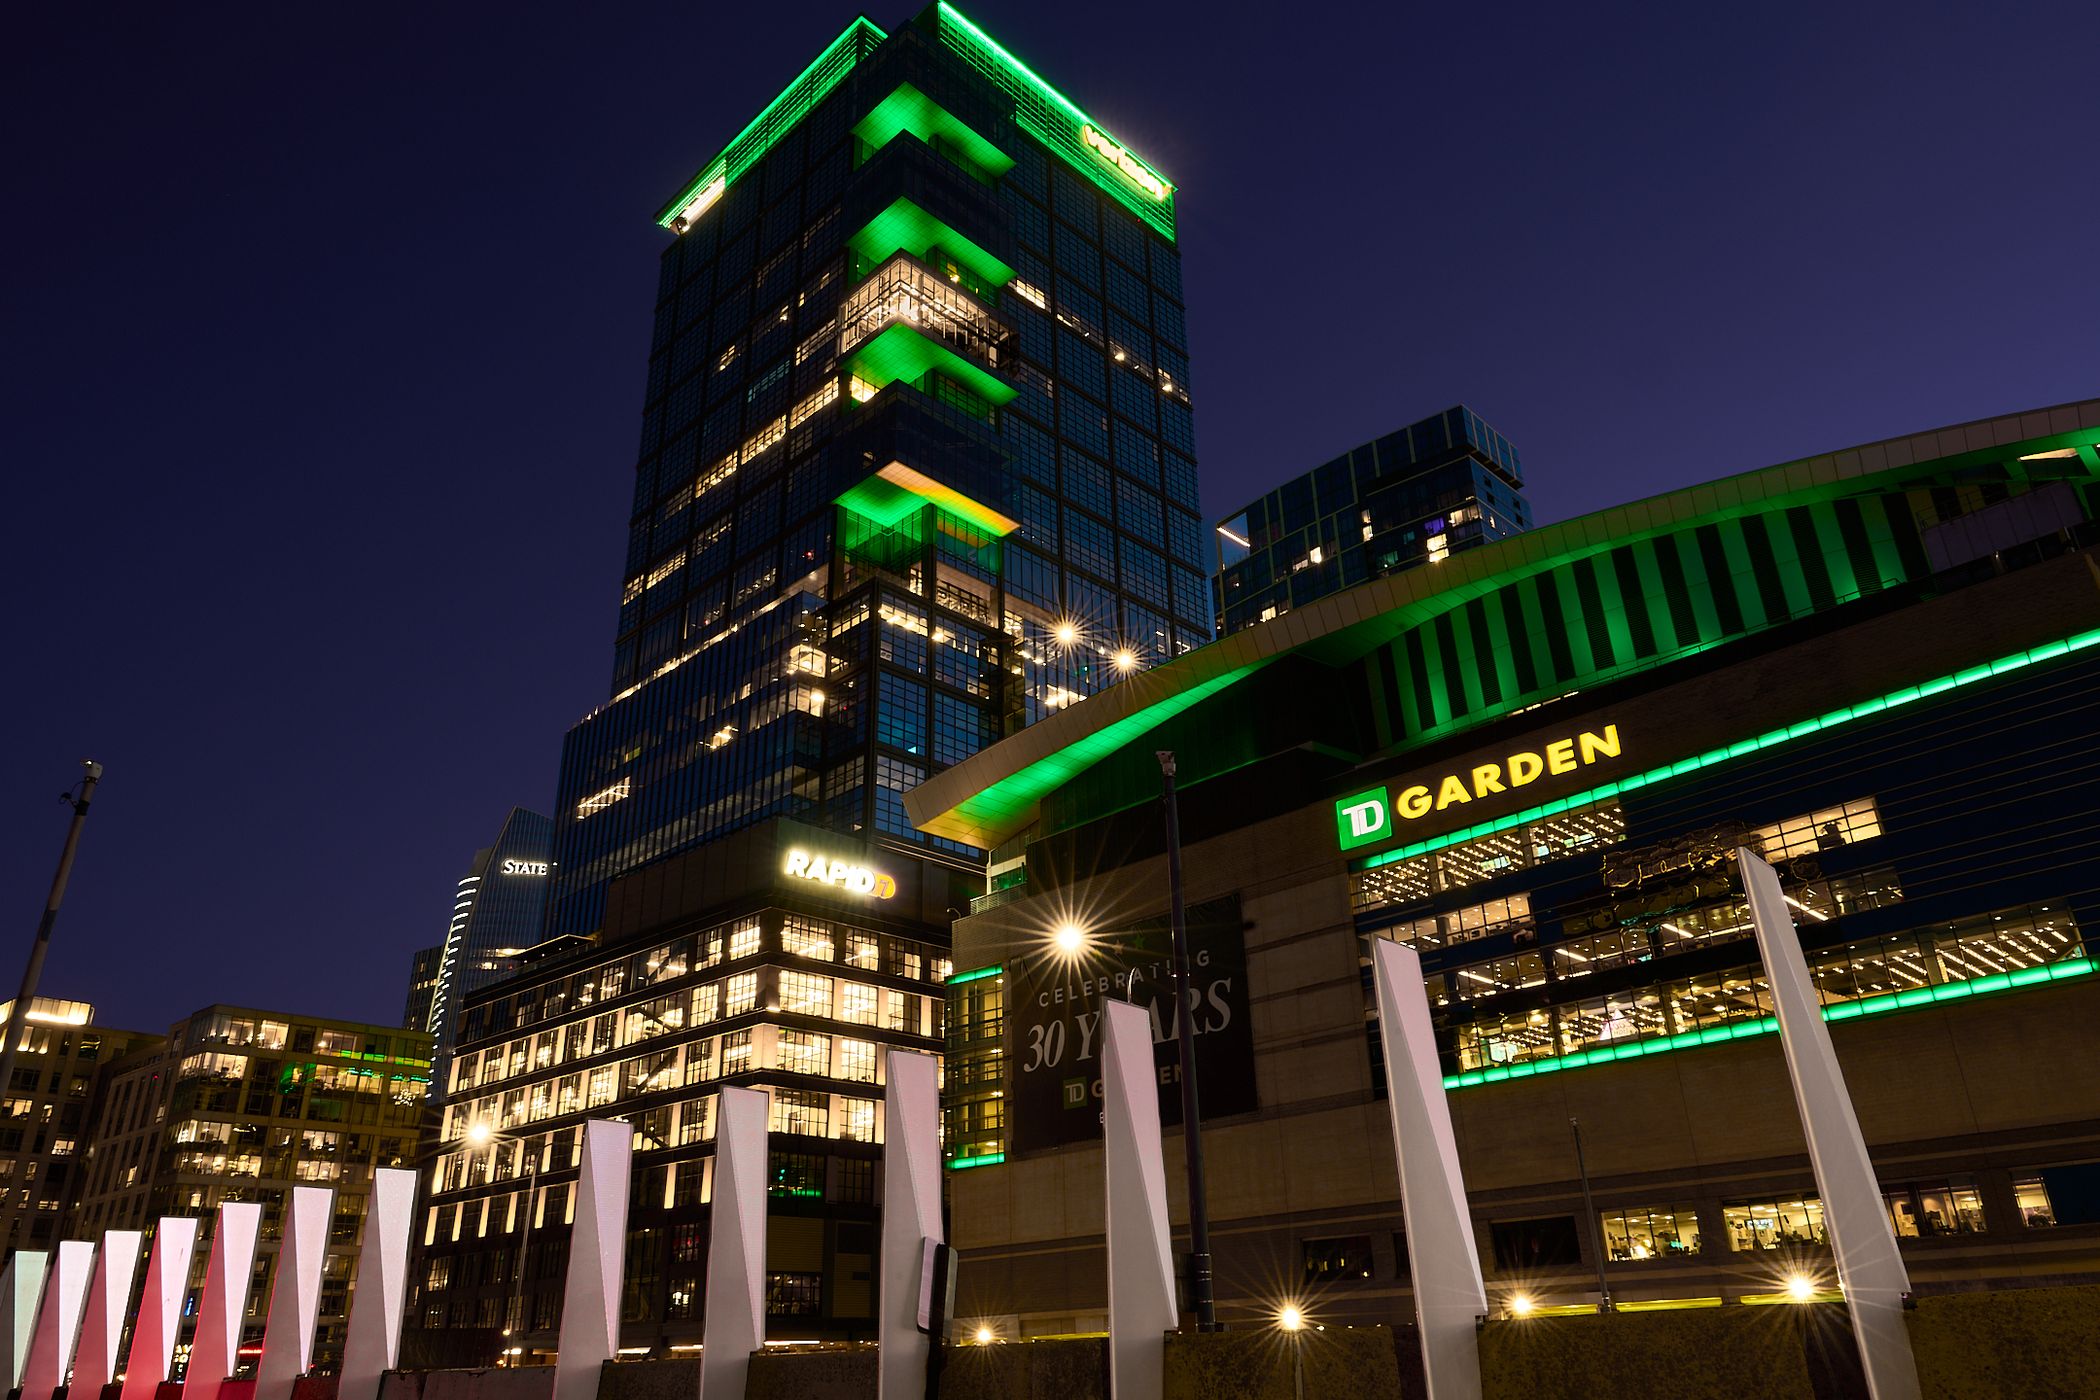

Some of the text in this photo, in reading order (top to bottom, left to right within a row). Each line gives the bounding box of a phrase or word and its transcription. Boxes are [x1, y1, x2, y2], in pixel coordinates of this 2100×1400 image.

[1396, 724, 1621, 819] GARDEN
[1023, 977, 1232, 1073] 30 YARS
[1039, 949, 1211, 1008] CELEBRATIG
